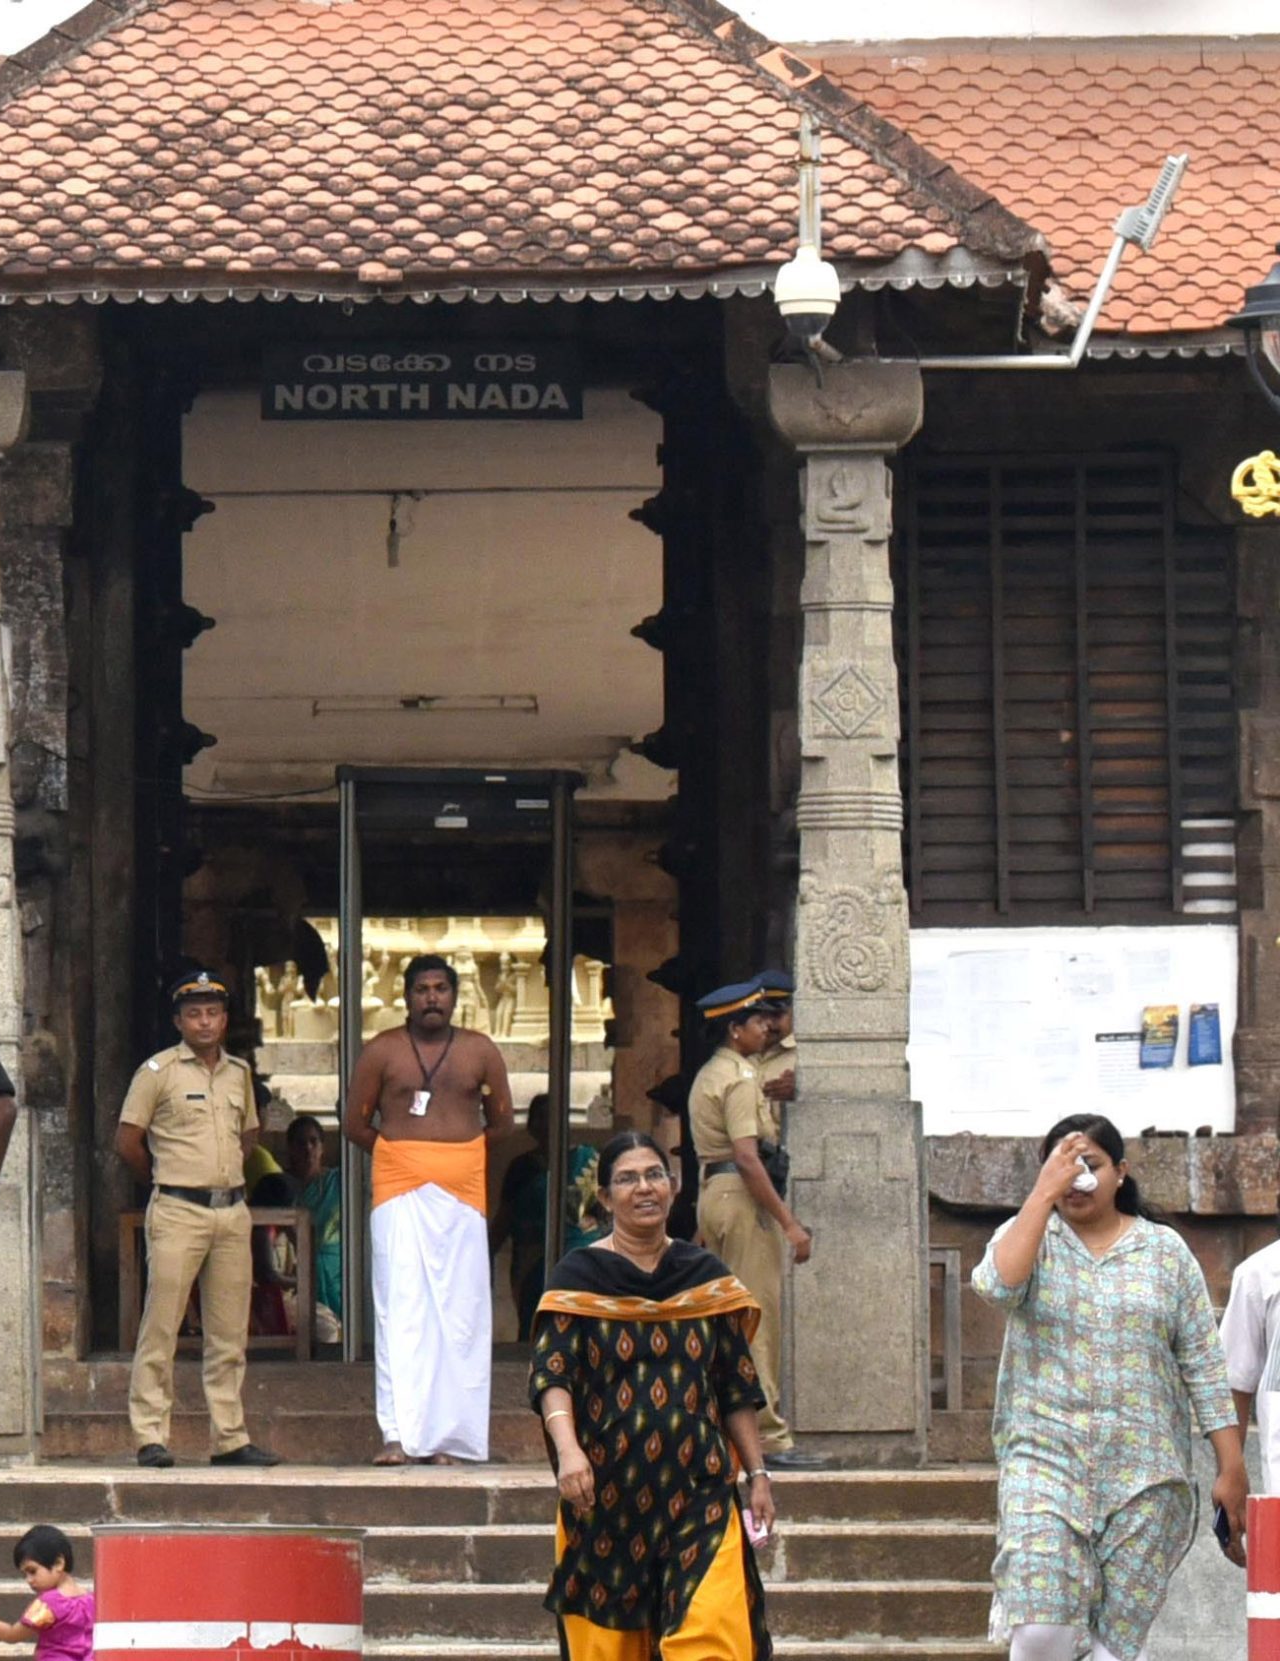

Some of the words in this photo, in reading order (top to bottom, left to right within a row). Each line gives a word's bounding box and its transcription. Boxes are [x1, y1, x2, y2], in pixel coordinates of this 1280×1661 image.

[473, 353, 537, 373] നട
[274, 383, 430, 411] NORTH
[447, 383, 569, 410] NADA
